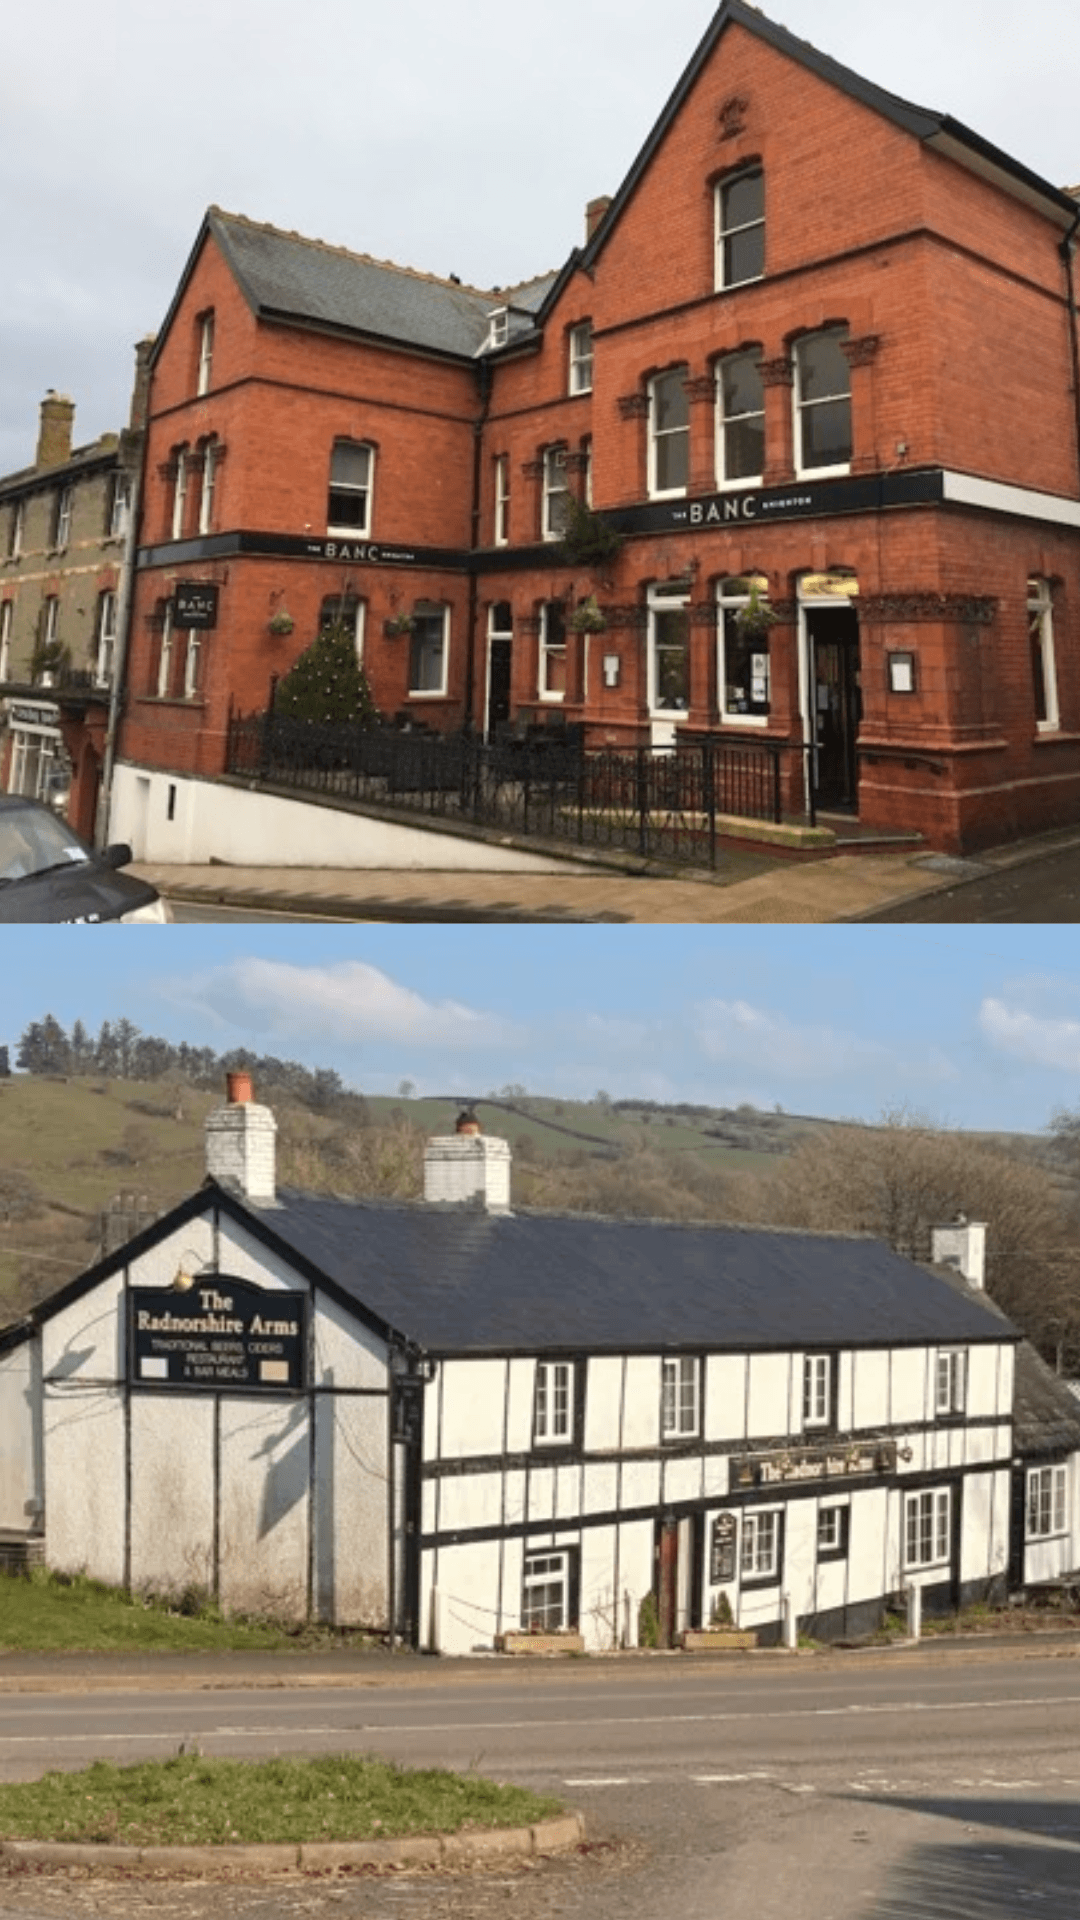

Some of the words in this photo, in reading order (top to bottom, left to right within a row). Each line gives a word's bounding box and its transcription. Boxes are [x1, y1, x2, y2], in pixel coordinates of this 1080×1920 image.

[689, 496, 756, 524] BANC
[325, 542, 379, 561] BANC
[200, 1289, 233, 1311] The
[137, 1310, 244, 1334] Radnorshire
[250, 1315, 298, 1336] Arms
